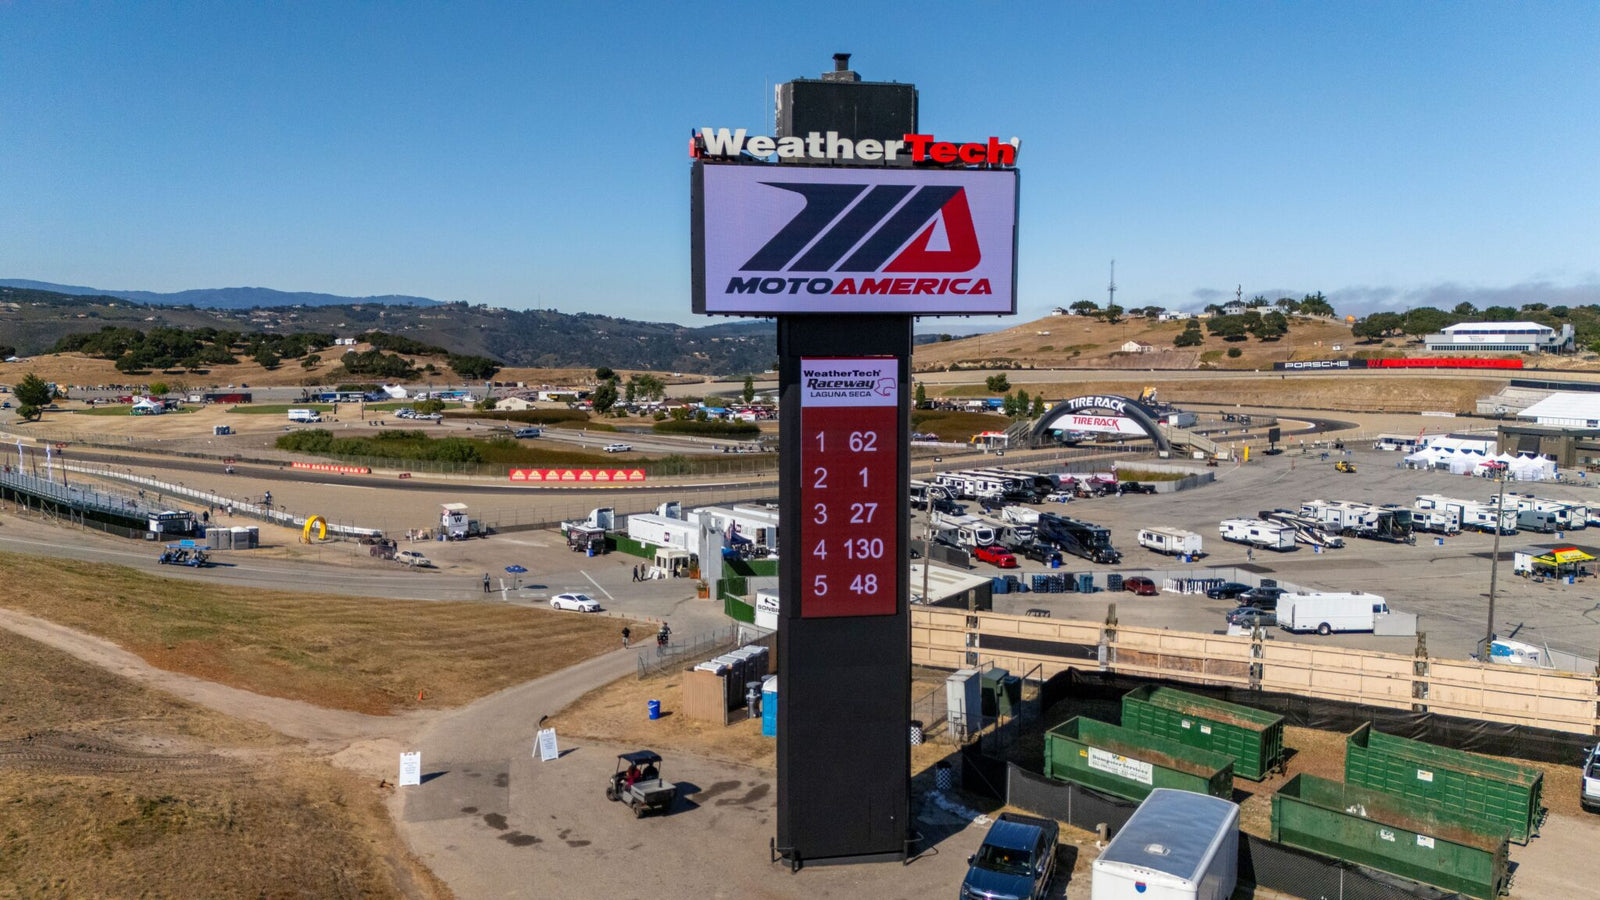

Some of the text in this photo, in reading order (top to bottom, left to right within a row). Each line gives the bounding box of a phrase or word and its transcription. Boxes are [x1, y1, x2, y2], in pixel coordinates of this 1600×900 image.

[701, 127, 1016, 165] WeatherTech
[725, 276, 992, 295] MOTOAMERICA
[803, 370, 880, 378] WeatherTech
[1284, 360, 1350, 369] PORSCHE
[807, 378, 875, 390] Raceway
[1068, 396, 1126, 413] TIRE RACK
[1072, 416, 1120, 431] TIRE RACK
[815, 431, 878, 452] 1 62
[813, 467, 869, 489] 2 1
[813, 503, 878, 525] 3 27
[813, 538, 884, 560] 4 130
[813, 574, 878, 596] 5 48
